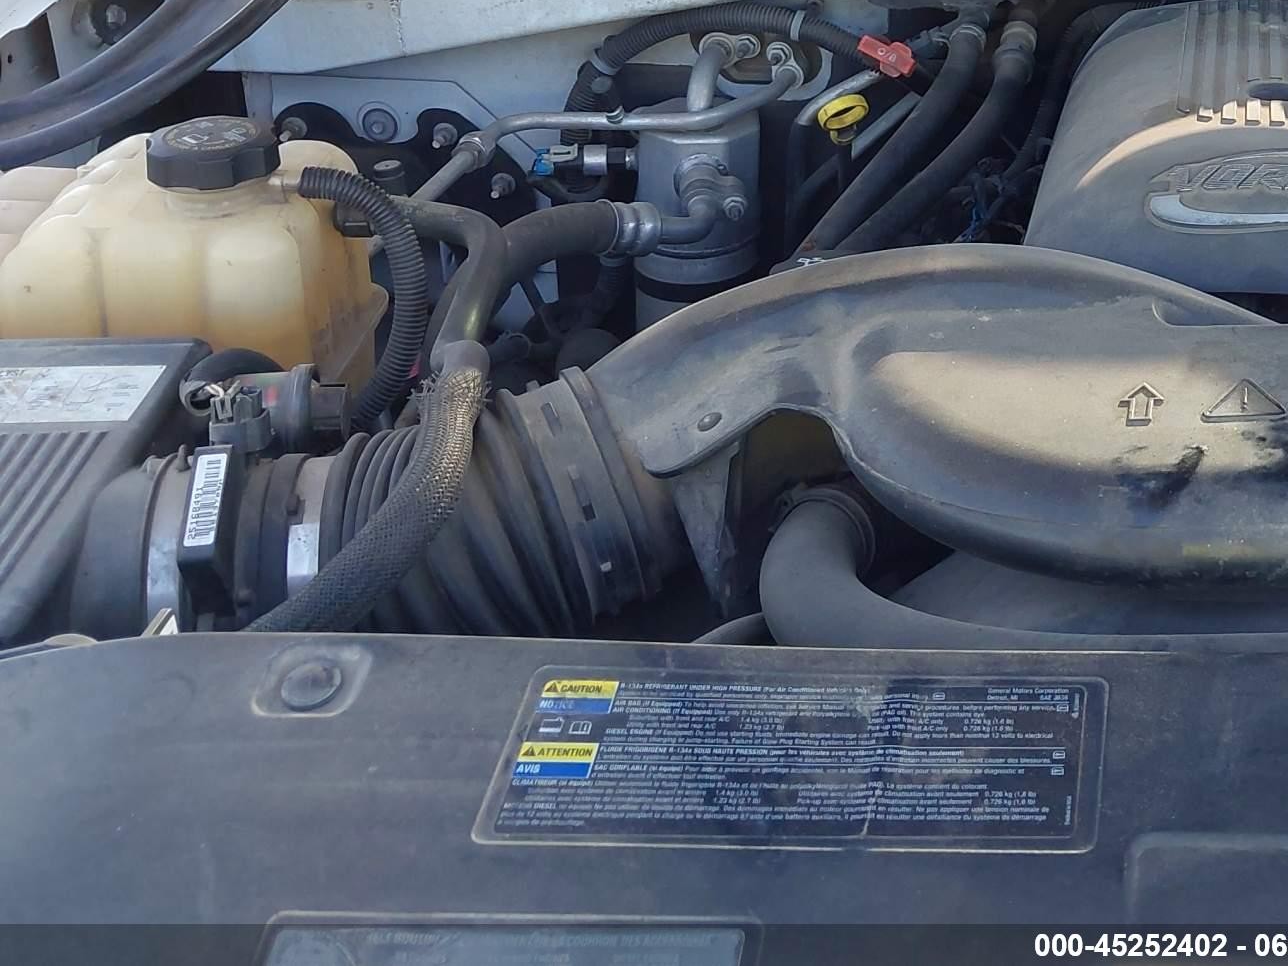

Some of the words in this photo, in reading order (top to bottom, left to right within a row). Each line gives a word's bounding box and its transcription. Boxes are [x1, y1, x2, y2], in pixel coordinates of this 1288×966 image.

[560, 684, 602, 693] CAUTION
[1034, 688, 1070, 696] Corporation
[536, 747, 594, 757] ATTENTION
[516, 765, 542, 774] AVIS
